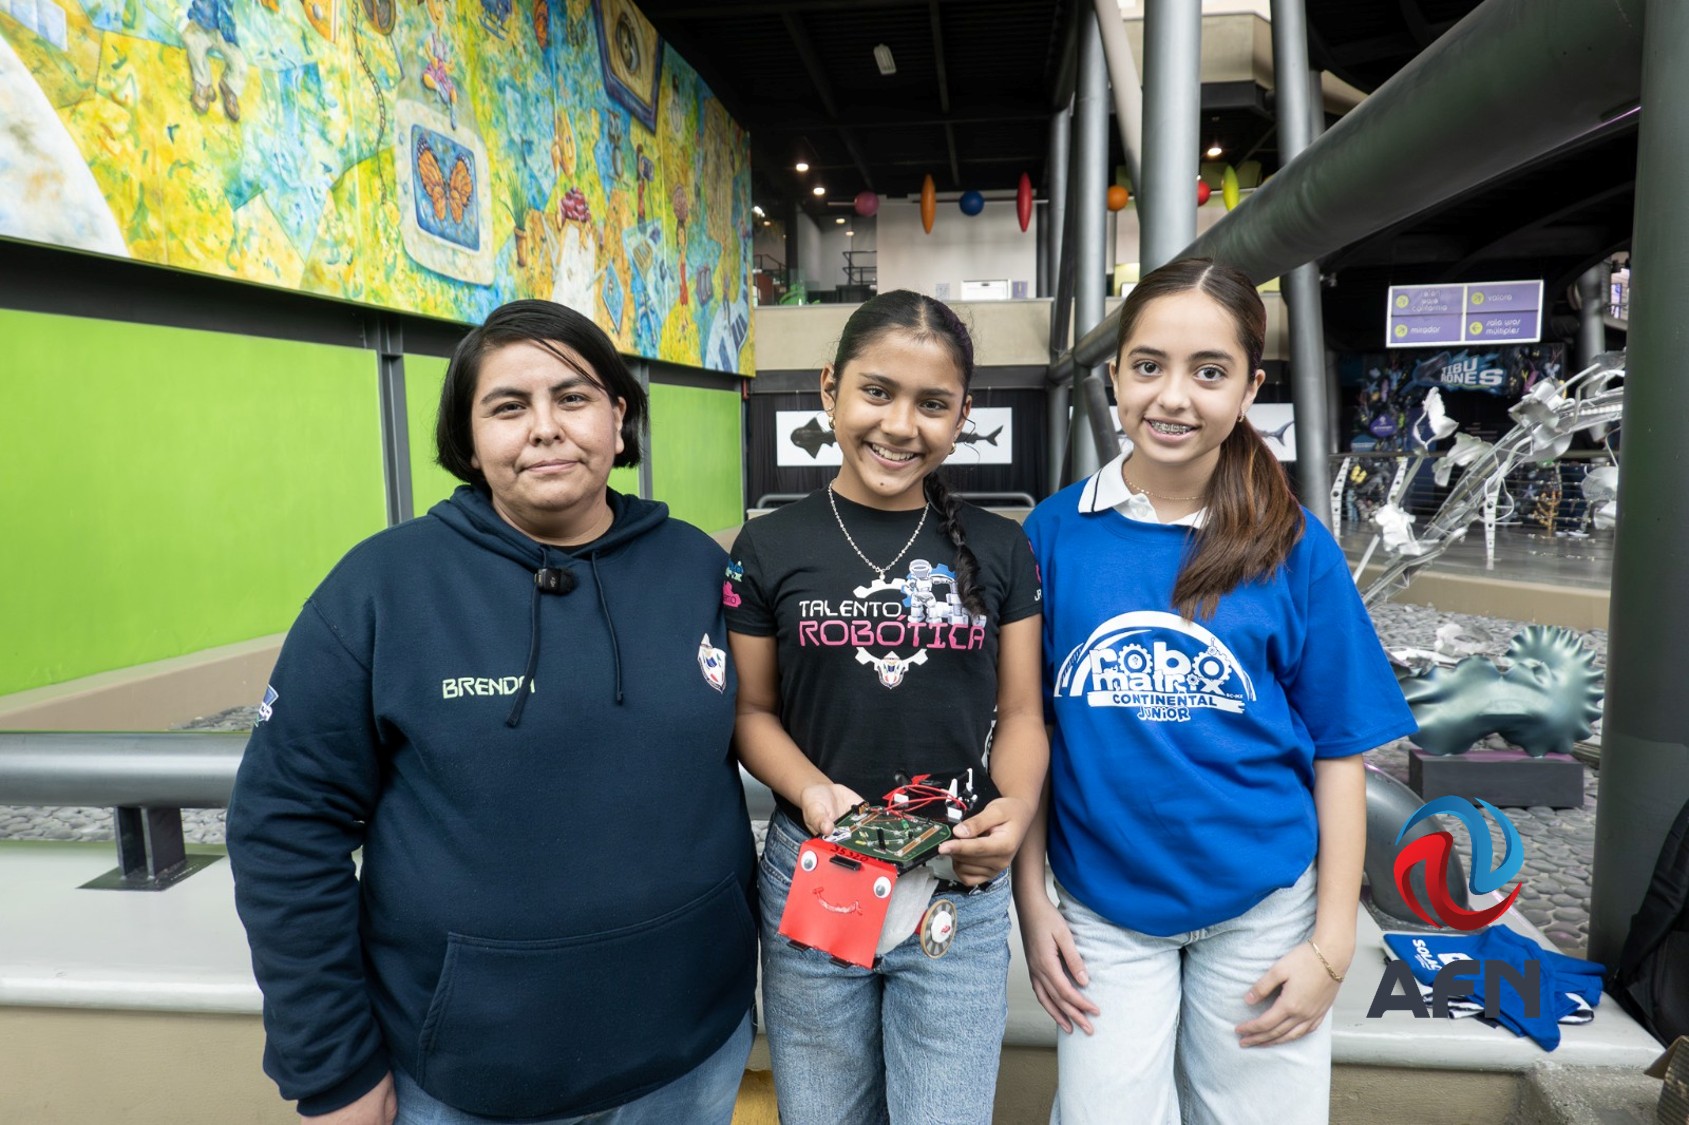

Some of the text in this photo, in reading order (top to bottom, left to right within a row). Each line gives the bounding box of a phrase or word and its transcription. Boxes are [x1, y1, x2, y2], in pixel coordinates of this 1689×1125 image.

[1410, 325, 1441, 334] mirador
[1441, 357, 1478, 375] TIBU
[1440, 368, 1503, 386] RONES
[799, 600, 902, 618] TALENTO
[799, 614, 986, 650] ROBÓTICA
[1093, 669, 1226, 696] matrix
[1112, 694, 1218, 707] CONTINENTAL
